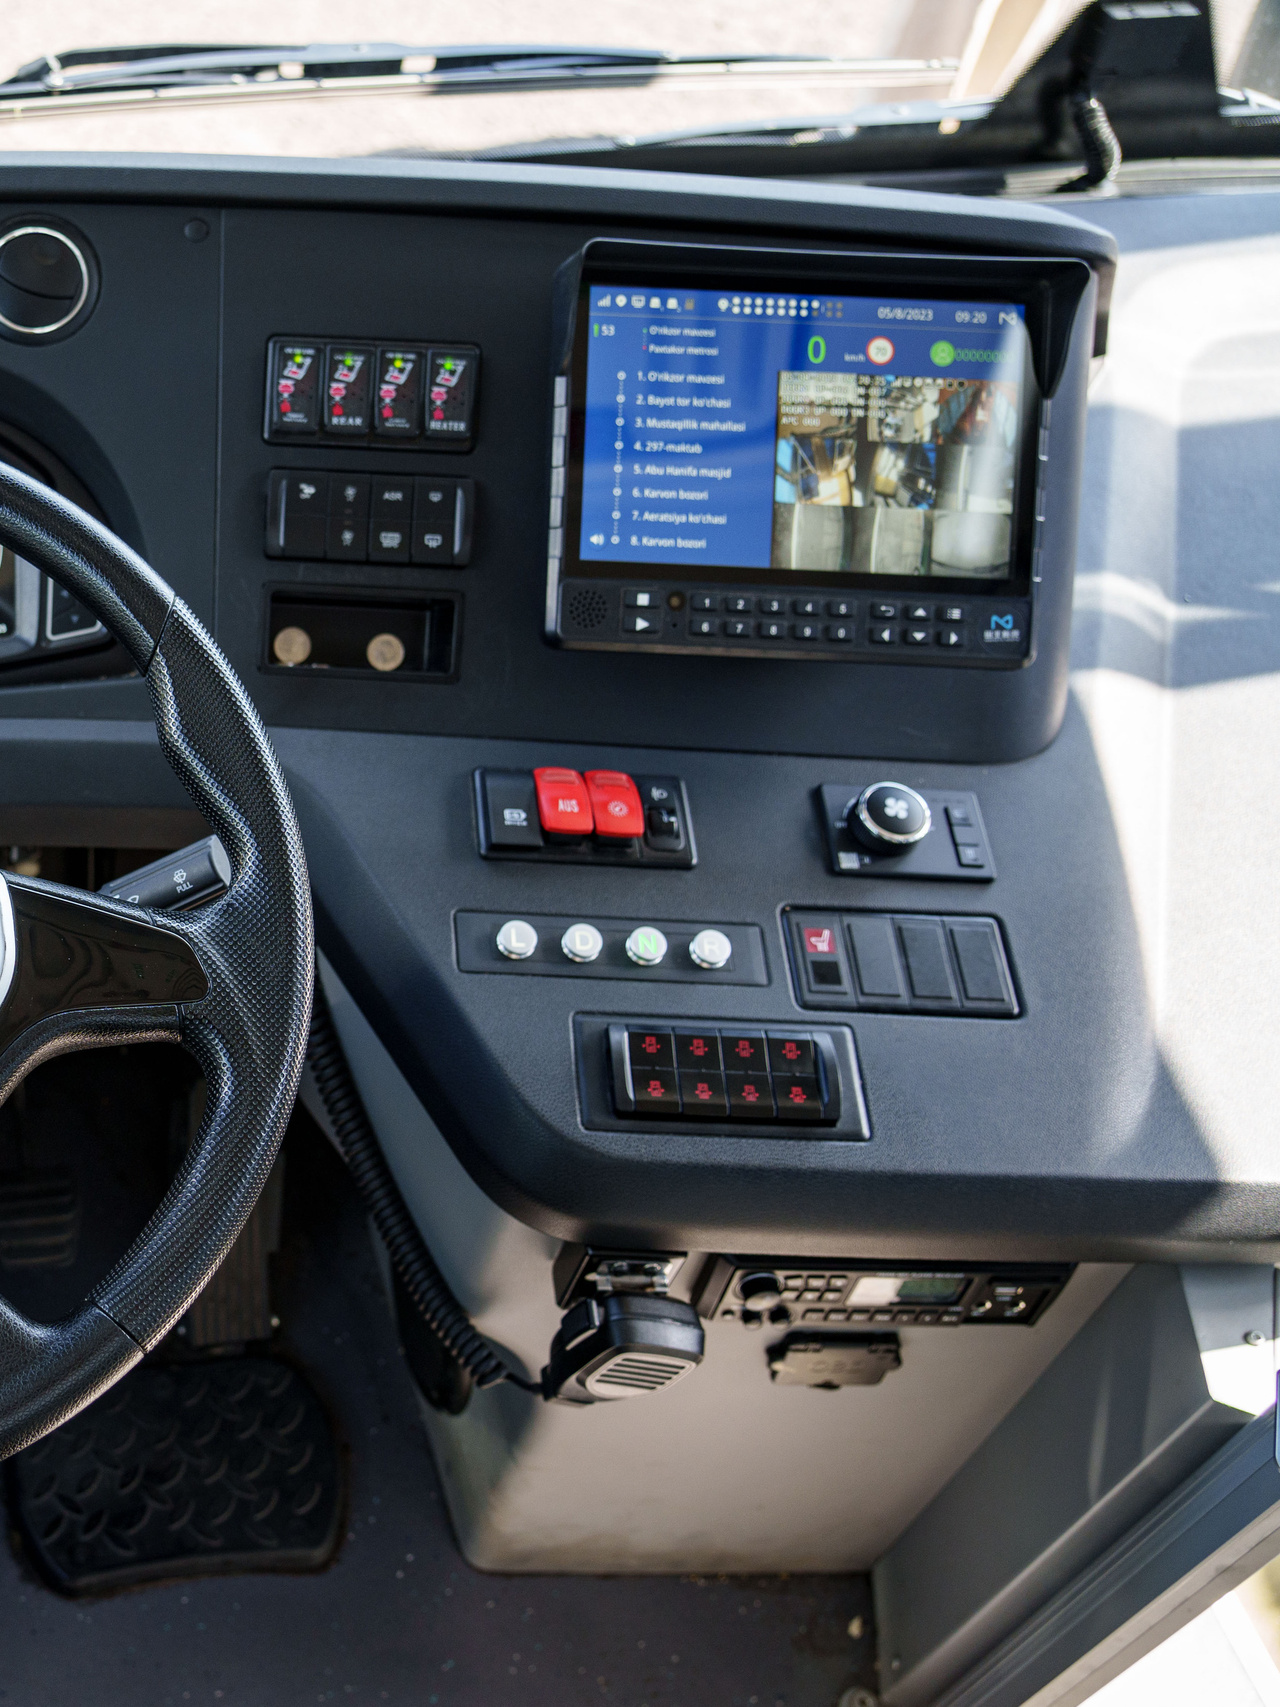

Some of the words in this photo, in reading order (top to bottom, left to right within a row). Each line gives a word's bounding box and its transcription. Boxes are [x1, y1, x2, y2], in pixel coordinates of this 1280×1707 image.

[877, 306, 933, 322] 05/8/2023
[955, 310, 987, 324] 09:20
[601, 324, 615, 336] 53
[807, 335, 827, 364] 0
[637, 370, 647, 381] 1.
[636, 393, 646, 405] 2.
[331, 416, 363, 426] REAR
[634, 416, 645, 428] 3.
[633, 440, 644, 451] 4.
[644, 464, 665, 475] Abu
[699, 467, 732, 480] masjid
[644, 487, 678, 499] Karvon
[678, 488, 709, 500] bozori
[632, 510, 641, 521] 7.
[641, 536, 675, 548] Karvon
[676, 537, 707, 549] bozori
[704, 597, 710, 608] 1
[736, 599, 745, 610] 2
[770, 600, 778, 611] 3
[805, 602, 812, 613] 4
[839, 604, 847, 615] 5
[701, 622, 709, 633] 6
[736, 623, 743, 634] 7
[770, 625, 778, 636] 8
[803, 626, 812, 637] 9
[837, 628, 845, 639] 0
[558, 799, 580, 813] AUS
[175, 881, 194, 894] PULL
[510, 927, 526, 949] L
[575, 930, 594, 951] D
[637, 933, 658, 955] N
[703, 935, 720, 956] R
